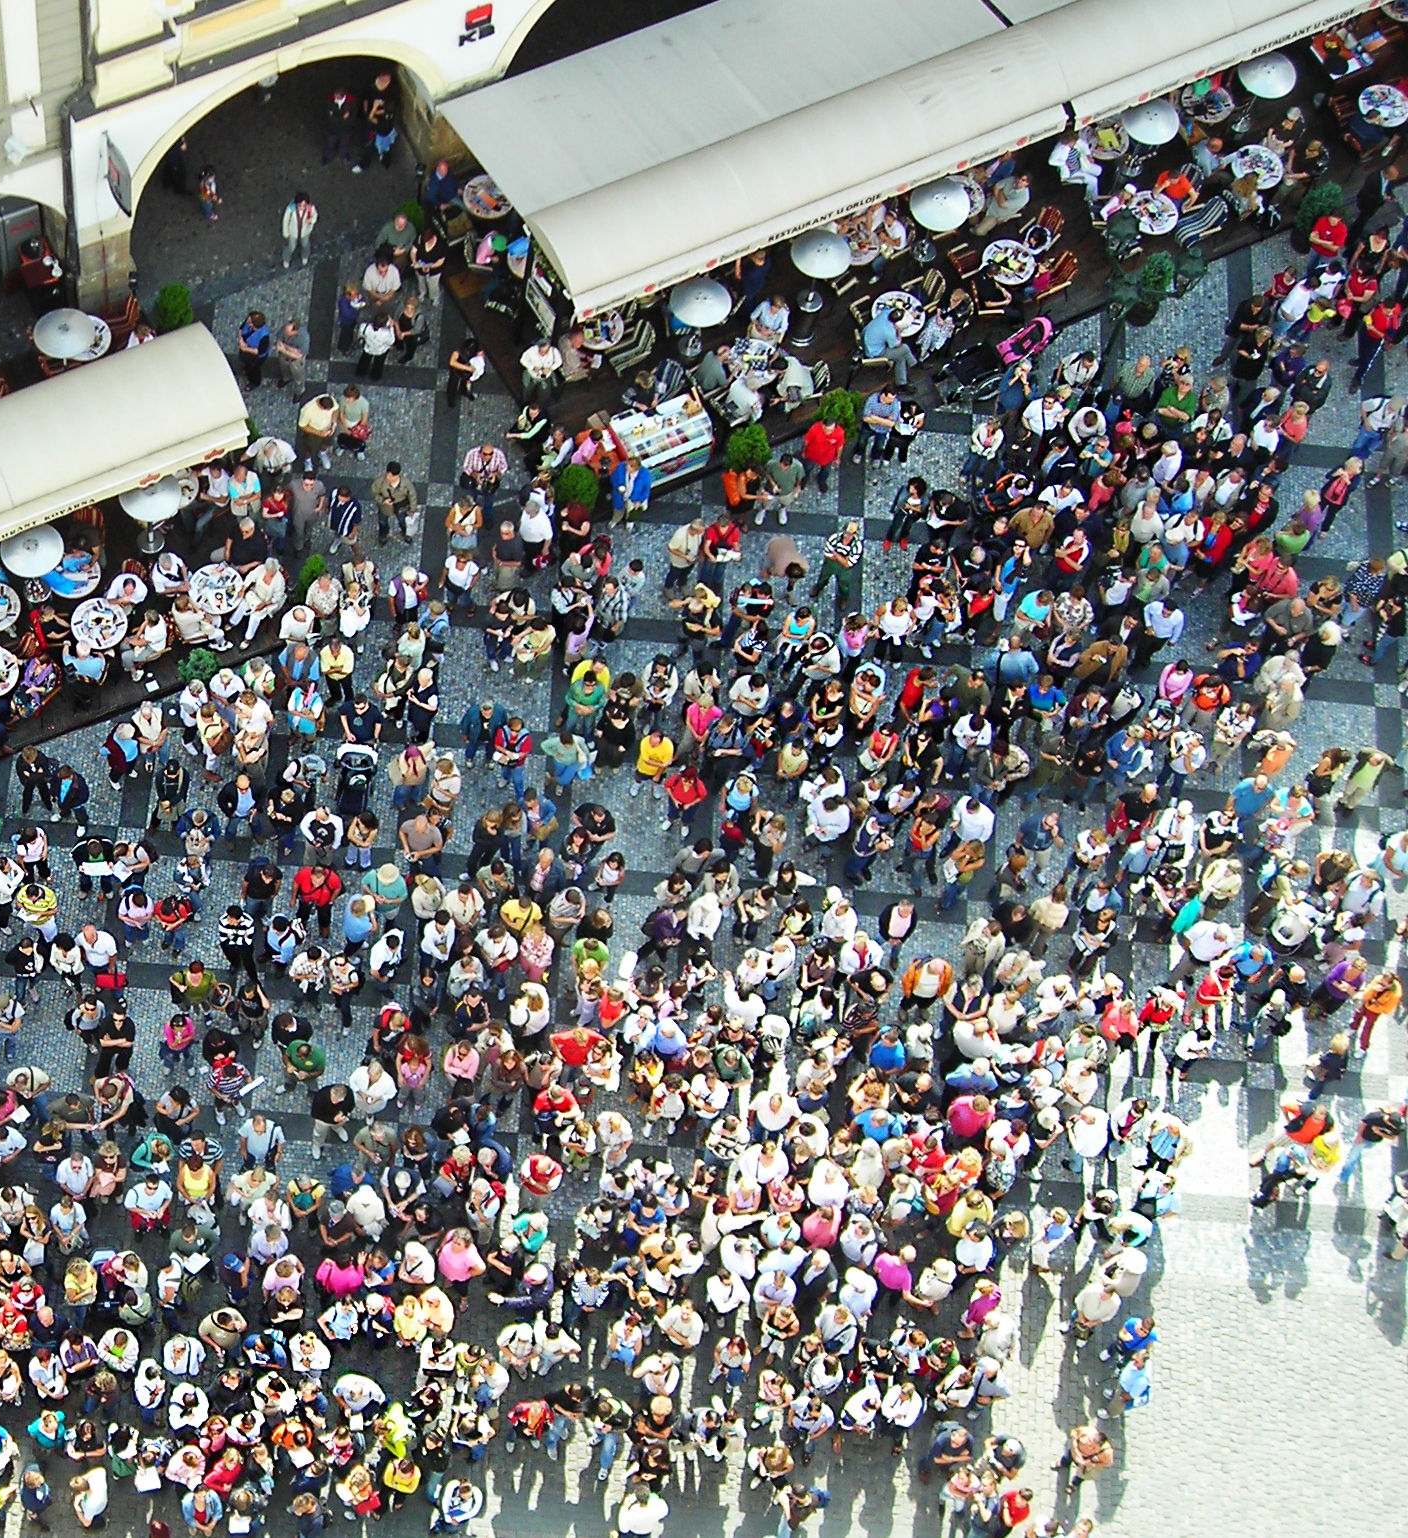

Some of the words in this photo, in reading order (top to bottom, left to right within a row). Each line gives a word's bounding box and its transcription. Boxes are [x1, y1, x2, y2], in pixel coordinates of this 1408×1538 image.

[767, 212, 835, 243] RESTAURANT
[835, 207, 845, 216] U
[844, 193, 883, 213] ORLOJE
